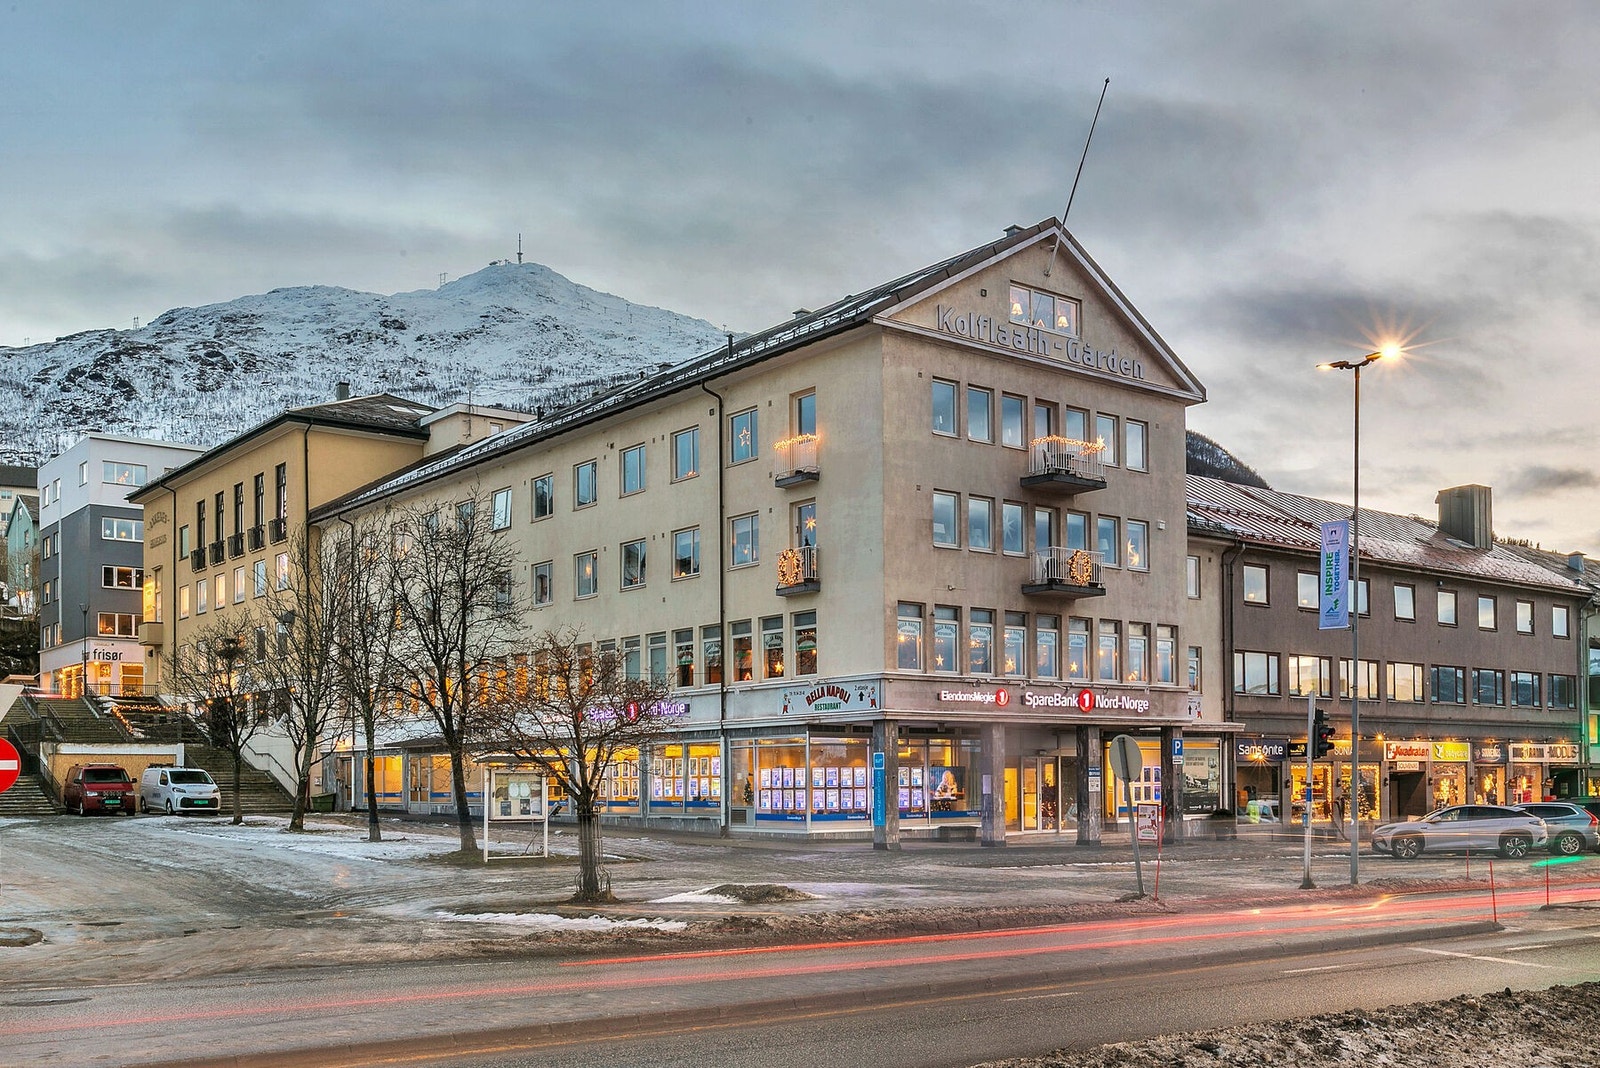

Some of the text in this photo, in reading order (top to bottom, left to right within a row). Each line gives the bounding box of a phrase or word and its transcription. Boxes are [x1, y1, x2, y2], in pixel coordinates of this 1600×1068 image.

[1325, 551, 1334, 596] INSPIRE
[93, 648, 123, 661] frisør
[805, 685, 851, 706] BELLA NAPOLI
[941, 690, 997, 704] EiendomsMegler
[1025, 691, 1079, 709] SpareBank
[1095, 694, 1150, 713] Nord-Norge
[814, 702, 842, 711] RESTAURANT
[1174, 741, 1182, 754] P
[1238, 744, 1284, 756] Samsonite
[1395, 745, 1429, 757] Kvadraten
